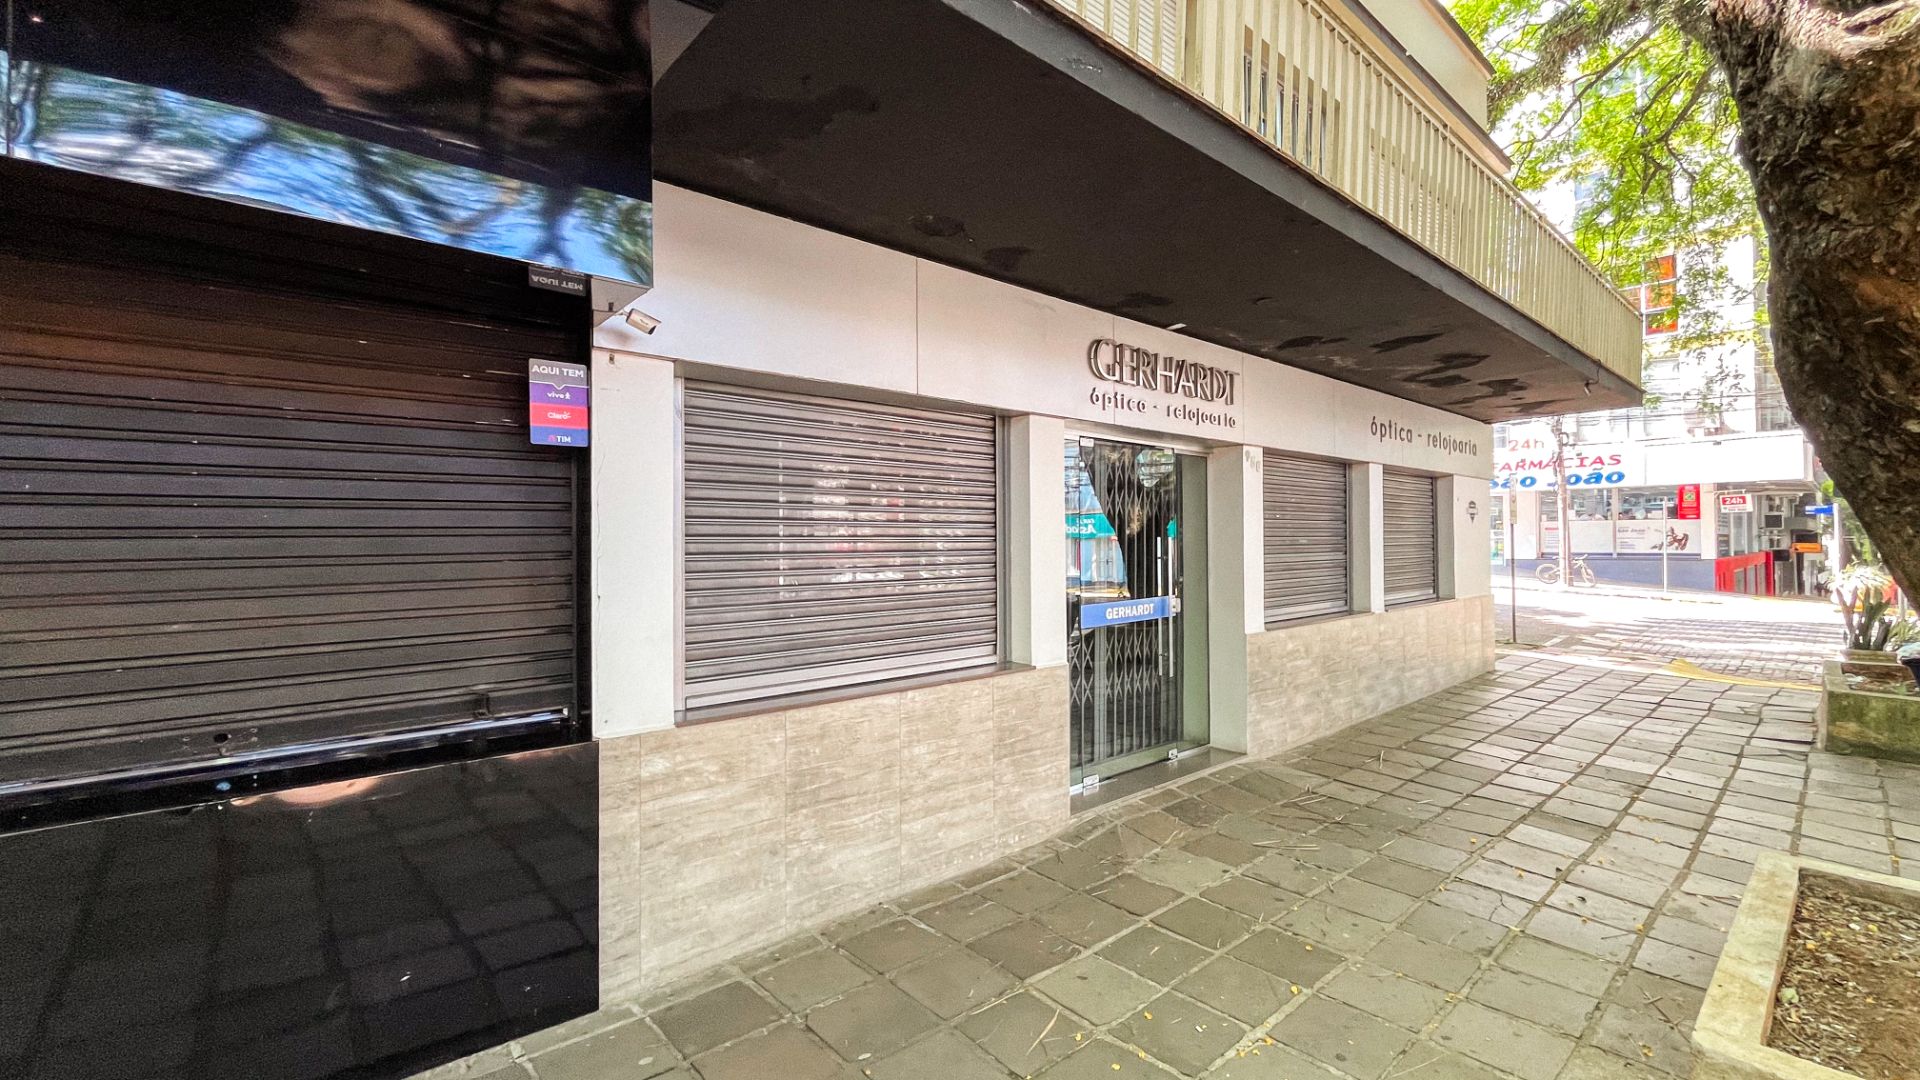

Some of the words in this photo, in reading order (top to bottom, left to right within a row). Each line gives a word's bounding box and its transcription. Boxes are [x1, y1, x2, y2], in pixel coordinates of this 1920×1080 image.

[531, 364, 560, 376] AQUI
[562, 367, 584, 378] TEM
[1087, 338, 1240, 405] GERHARDT
[1090, 387, 1147, 413] óptica
[1166, 404, 1236, 428] relojoaria
[547, 411, 569, 420] Claro
[556, 435, 572, 443] TIM
[1370, 416, 1413, 443] óptica
[1427, 432, 1477, 456] relojoaria
[1508, 438, 1544, 451] 24h
[1546, 467, 1625, 488] oão
[1725, 496, 1743, 504] 24h
[1105, 603, 1155, 620] GERHARDT
